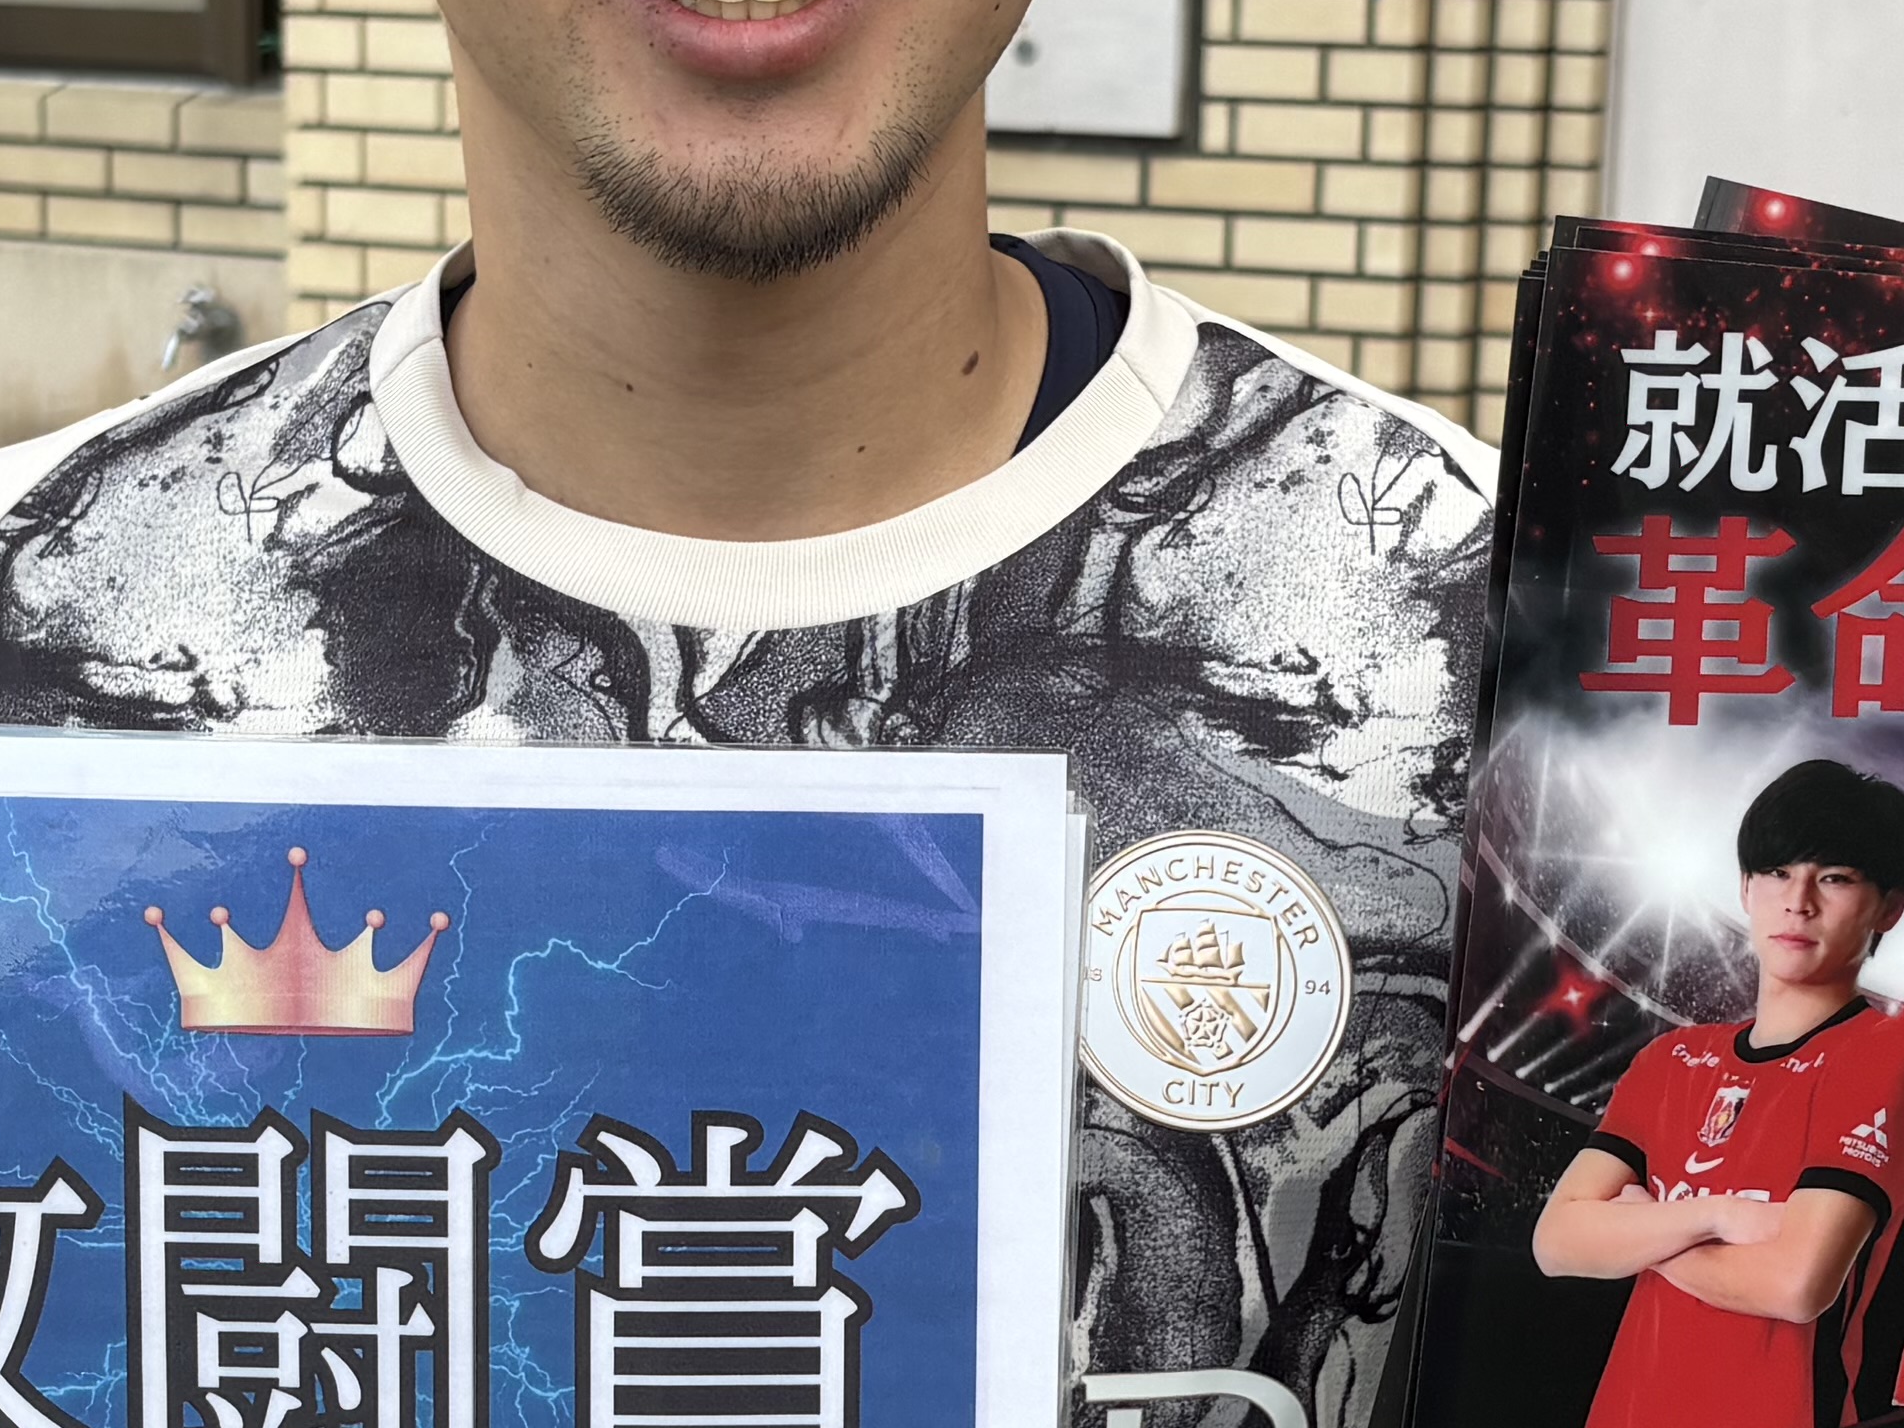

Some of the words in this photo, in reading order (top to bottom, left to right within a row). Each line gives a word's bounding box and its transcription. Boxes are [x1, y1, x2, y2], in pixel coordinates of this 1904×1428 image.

[1091, 854, 1320, 950] MANCHESTER
[1304, 979, 1331, 995] 94
[1161, 1079, 1246, 1107] CITY
